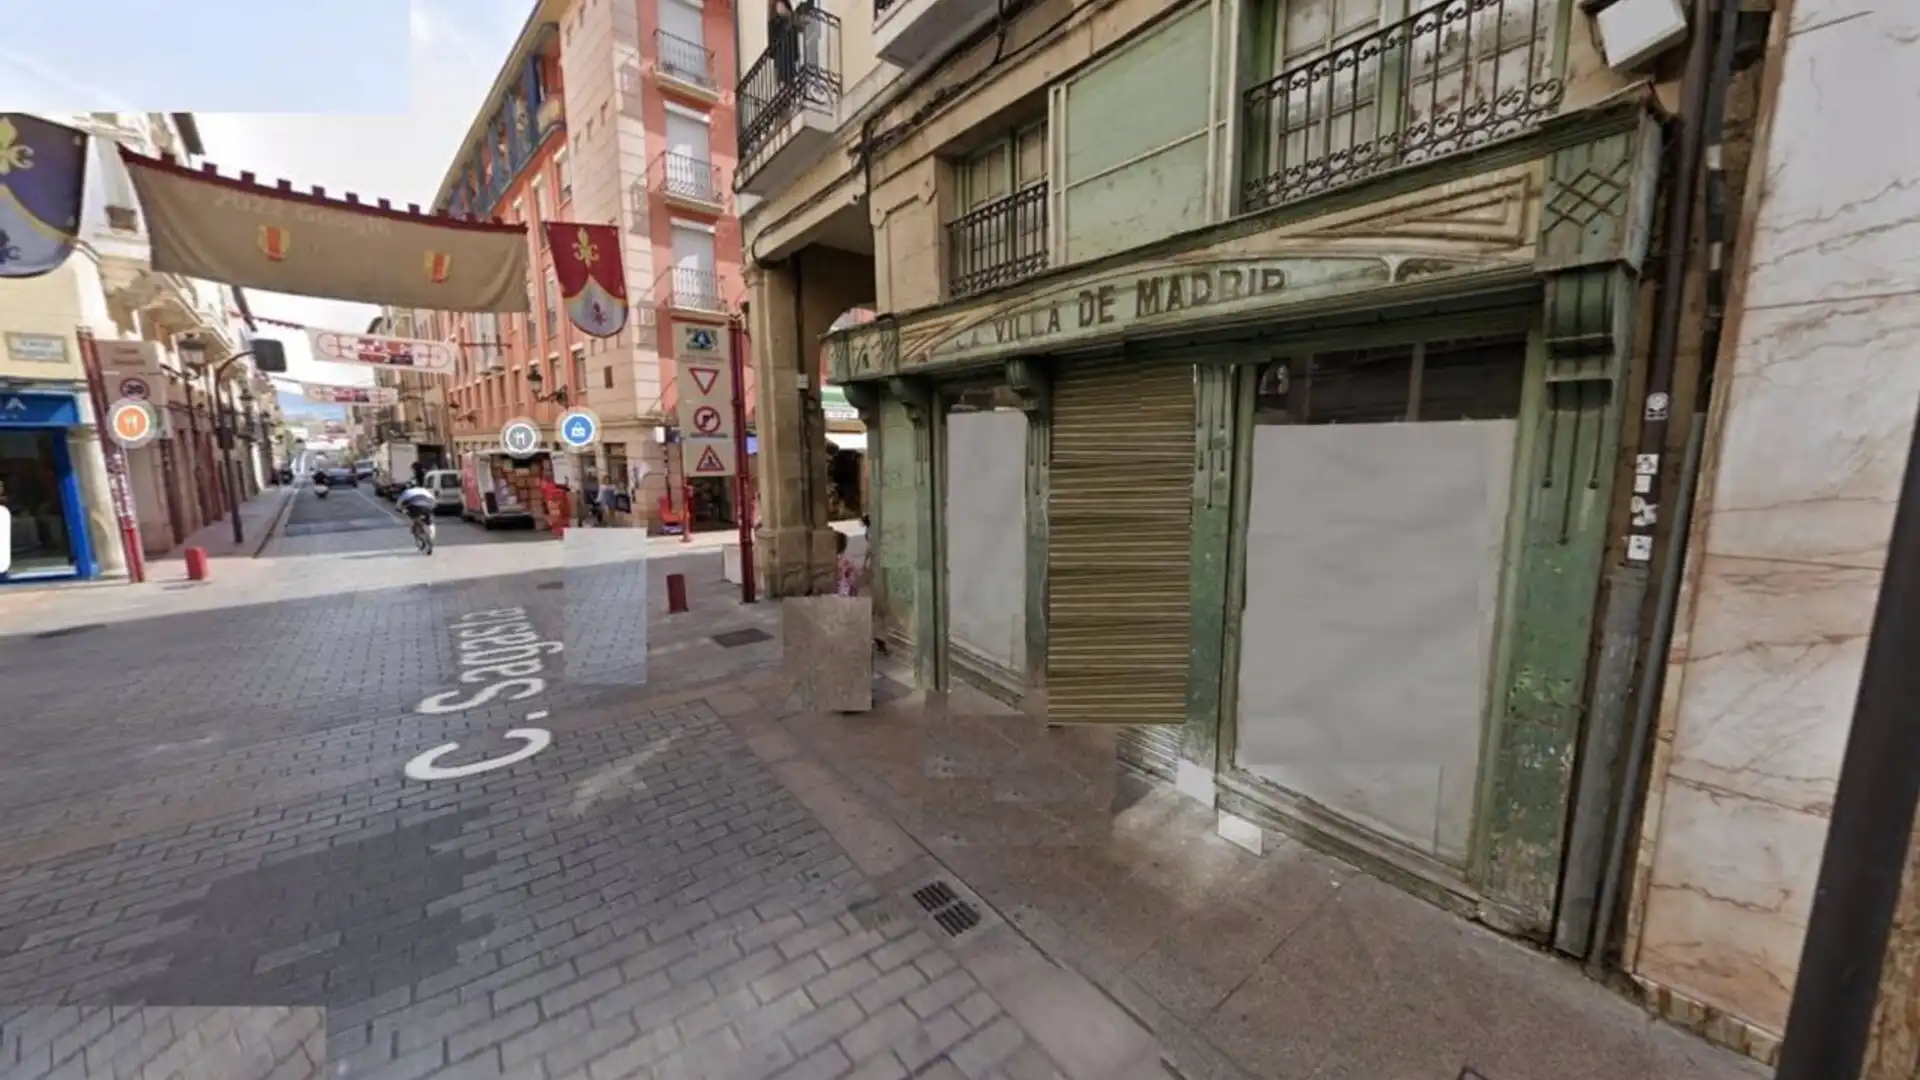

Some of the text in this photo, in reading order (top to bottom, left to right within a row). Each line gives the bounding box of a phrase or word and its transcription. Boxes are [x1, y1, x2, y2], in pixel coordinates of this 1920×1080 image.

[992, 307, 1061, 344] VILLA
[1077, 284, 1115, 328] DE
[1136, 267, 1286, 318] MADRID
